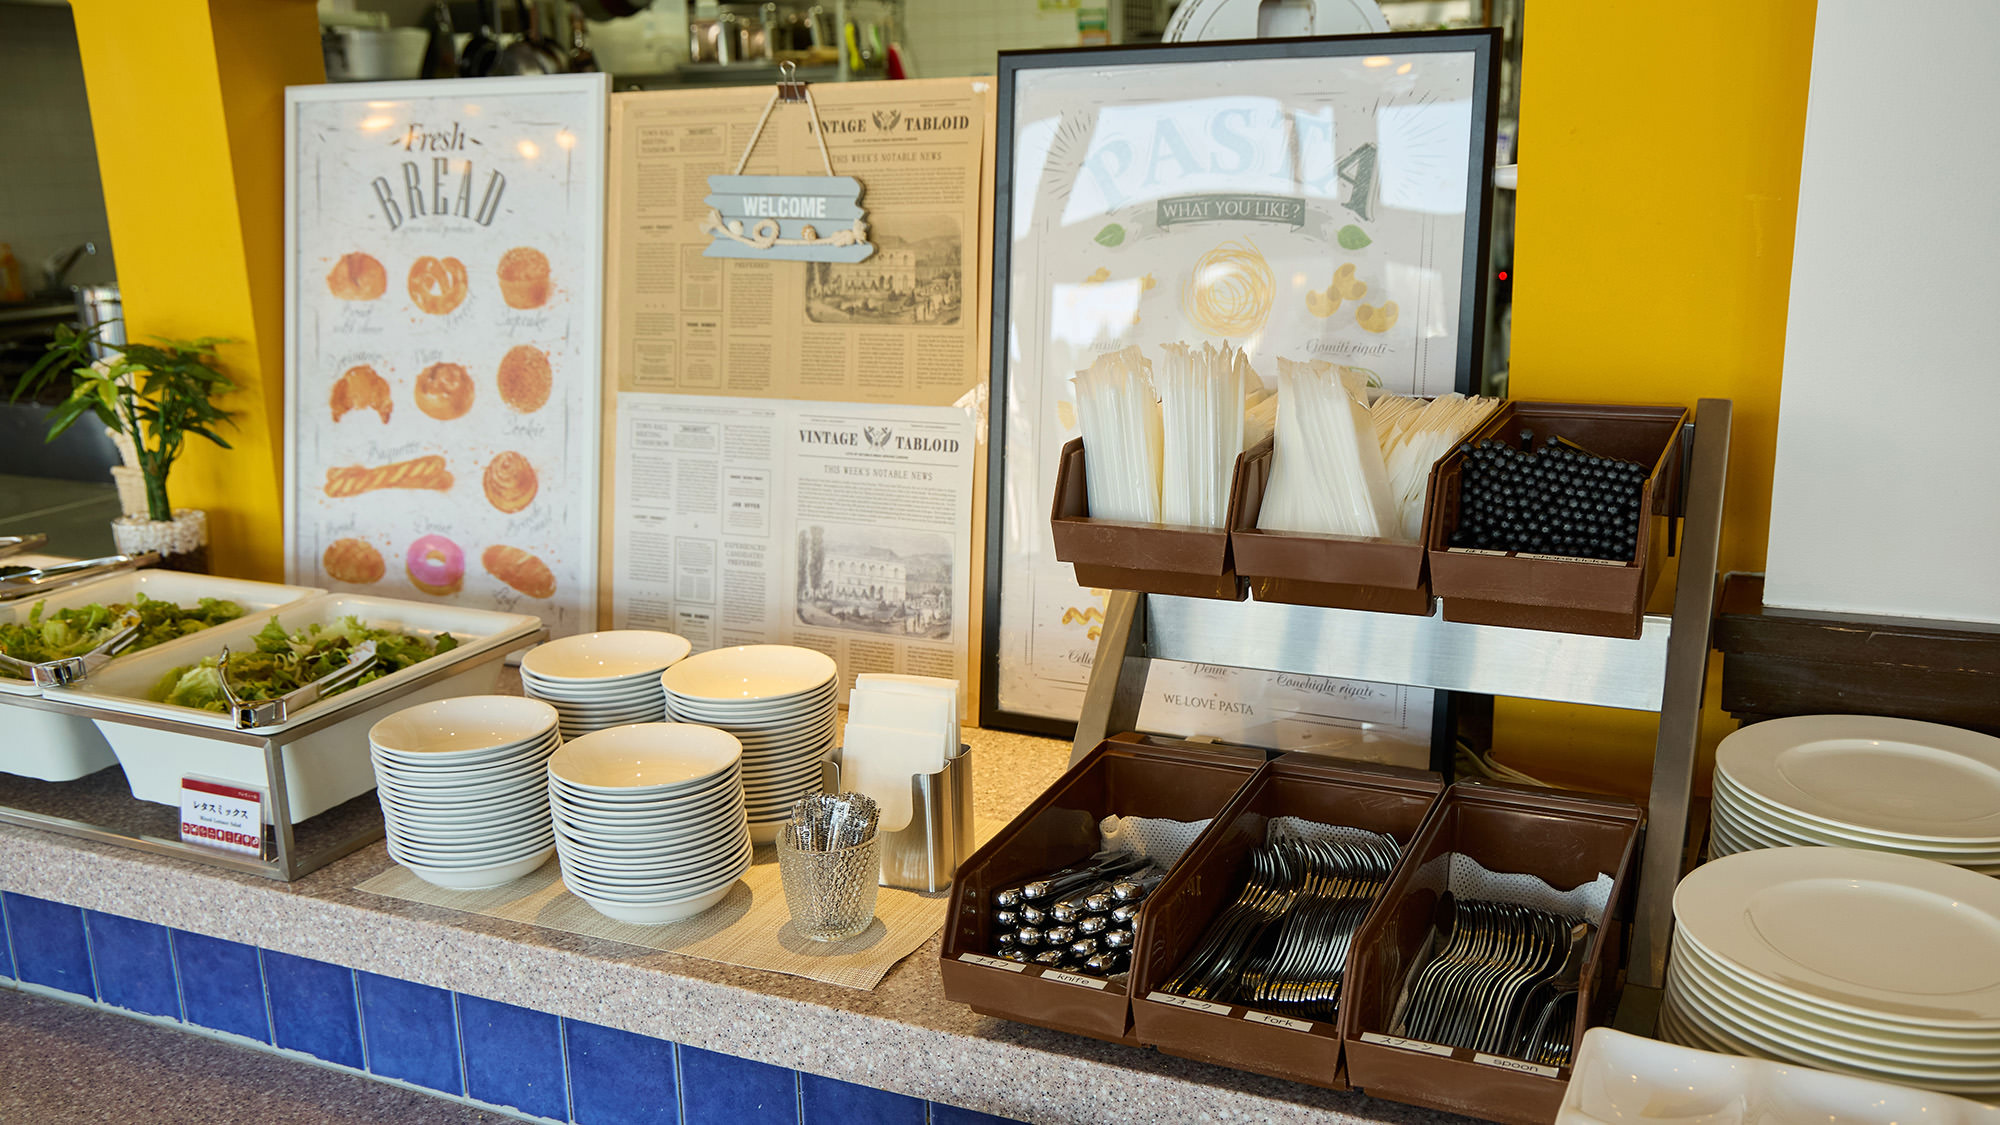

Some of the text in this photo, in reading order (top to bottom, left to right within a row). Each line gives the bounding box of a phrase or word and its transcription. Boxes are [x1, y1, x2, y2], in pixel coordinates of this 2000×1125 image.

[808, 115, 970, 134] VNTAGE TABLOID
[403, 121, 465, 151] Fresh
[881, 151, 918, 162] NOTABLE
[920, 151, 942, 161] NEWS
[1081, 107, 1379, 222] PASTA
[371, 157, 507, 231] BREAD
[743, 195, 826, 218] WELCOME
[1162, 202, 1211, 217] WHAT
[1215, 201, 1251, 216] YOU
[1352, 343, 1388, 357] rigati
[799, 429, 959, 453] VINTAGE TABLOID
[824, 464, 840, 475] THIS
[872, 468, 908, 479] NOTABLE
[911, 471, 934, 481] NEWS
[1193, 662, 1228, 676] Penne
[1277, 674, 1374, 697] Conchiglie rigate
[1163, 693, 1254, 715] WE LOVE PASTA
[193, 800, 248, 819] レタスミックス
[976, 956, 1009, 968] ナイフ
[1056, 973, 1090, 985] knife
[1167, 995, 1213, 1010] フォーク
[1263, 1015, 1294, 1028] fork
[1380, 1035, 1433, 1051] スプーン
[1493, 1057, 1539, 1074] spoon
